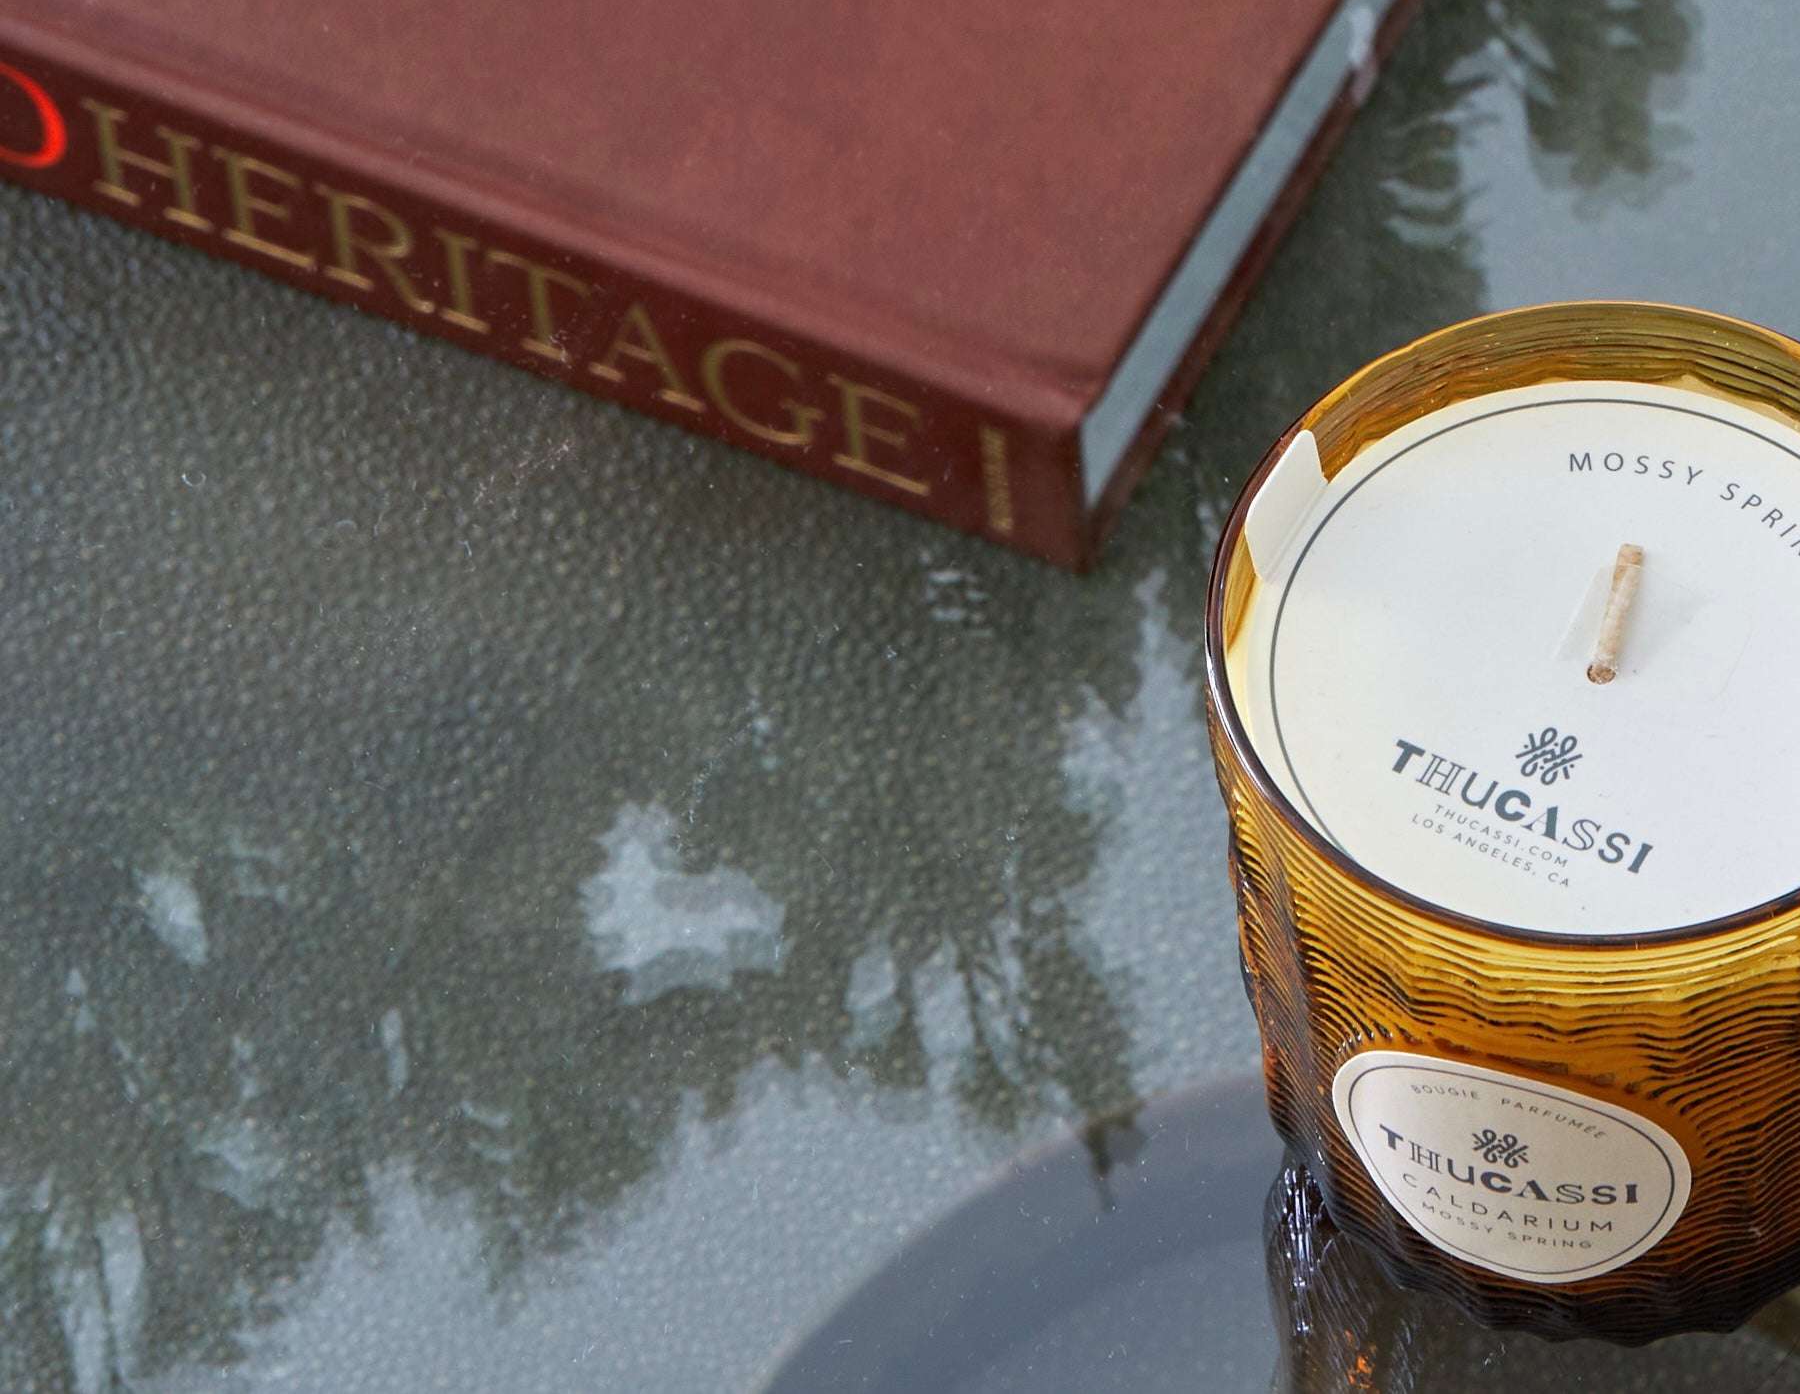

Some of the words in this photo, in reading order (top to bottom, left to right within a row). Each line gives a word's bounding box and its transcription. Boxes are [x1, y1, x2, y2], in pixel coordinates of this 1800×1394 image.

[80, 97, 931, 496] HERITAGE
[1569, 452, 1704, 486] MOSSY
[1391, 739, 1654, 875] THUCASSI
[1434, 804, 1569, 869] THUCASSI.COM
[1411, 813, 1445, 835] LOS
[1453, 831, 1537, 877] ANGELES,
[1547, 871, 1570, 889] CA
[1410, 1083, 1481, 1101] BOUGIE
[1501, 1097, 1607, 1140] PARFUMÉE
[1379, 1123, 1639, 1206] THUCASSI
[1402, 1173, 1614, 1233] CALDARIUM
[1421, 1200, 1494, 1234] MOSSY
[1507, 1230, 1594, 1250] SPRING
